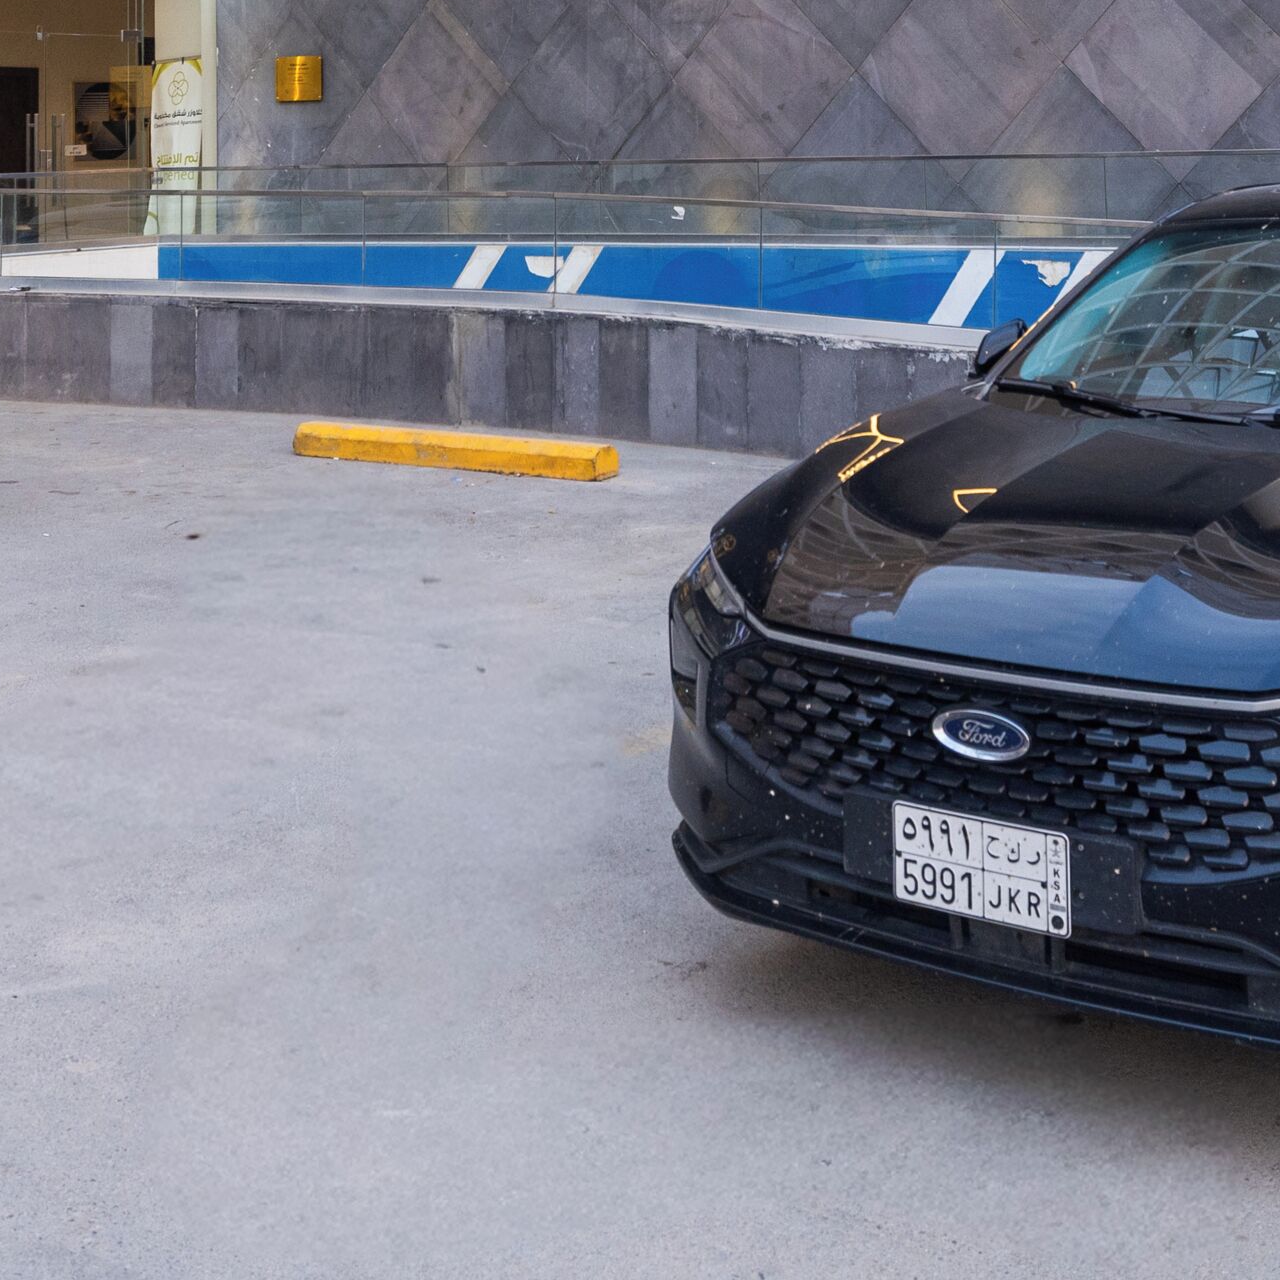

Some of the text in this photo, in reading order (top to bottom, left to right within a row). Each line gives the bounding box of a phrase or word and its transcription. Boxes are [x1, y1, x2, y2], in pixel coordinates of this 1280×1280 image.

[958, 719, 1007, 748] Ford
[903, 858, 1041, 918] 5991 JKR
